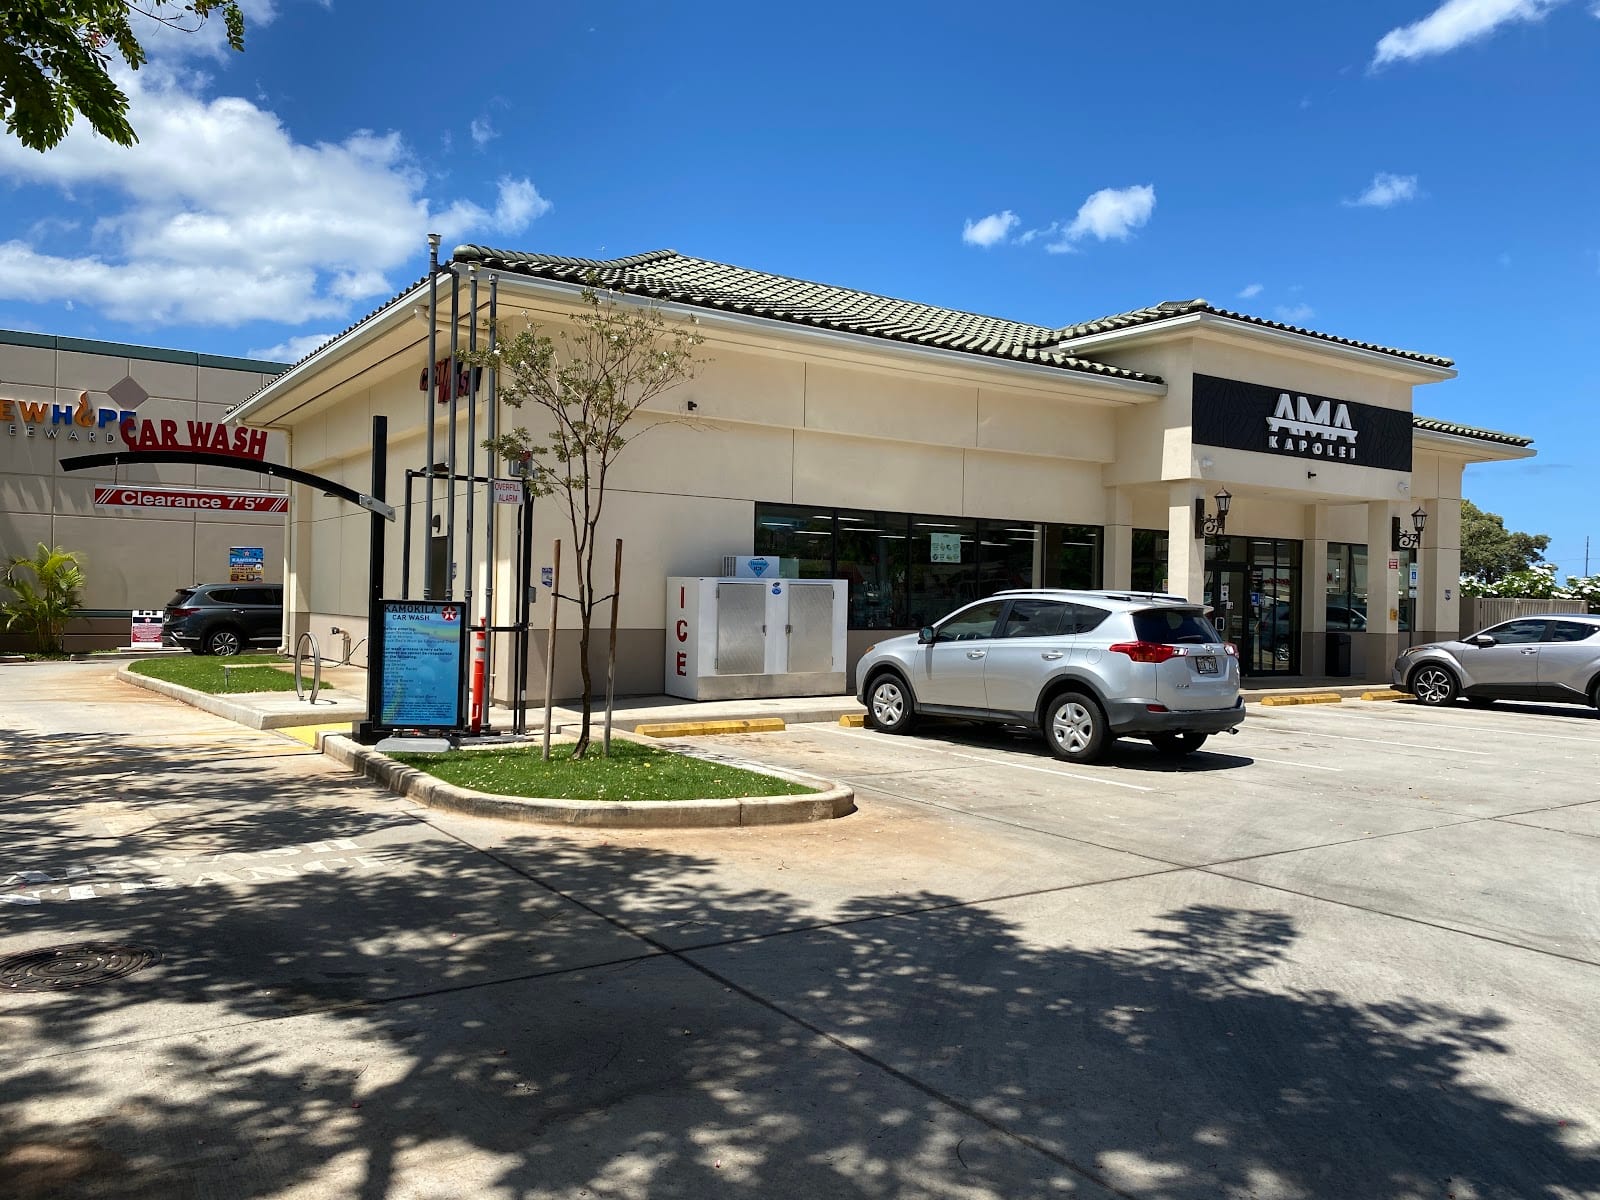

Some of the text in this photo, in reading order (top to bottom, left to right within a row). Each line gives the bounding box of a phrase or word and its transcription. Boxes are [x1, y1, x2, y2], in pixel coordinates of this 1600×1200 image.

[1266, 393, 1358, 441] AMA
[9, 424, 116, 443] EEWARD
[120, 418, 267, 459] CAR WASH
[1269, 436, 1356, 459] KAPOLEI
[495, 482, 520, 491] OVERFILL
[120, 491, 222, 509] Clearance
[498, 493, 518, 502] ALARM
[384, 604, 438, 613] KAMOKILA
[676, 587, 688, 676] ICE
